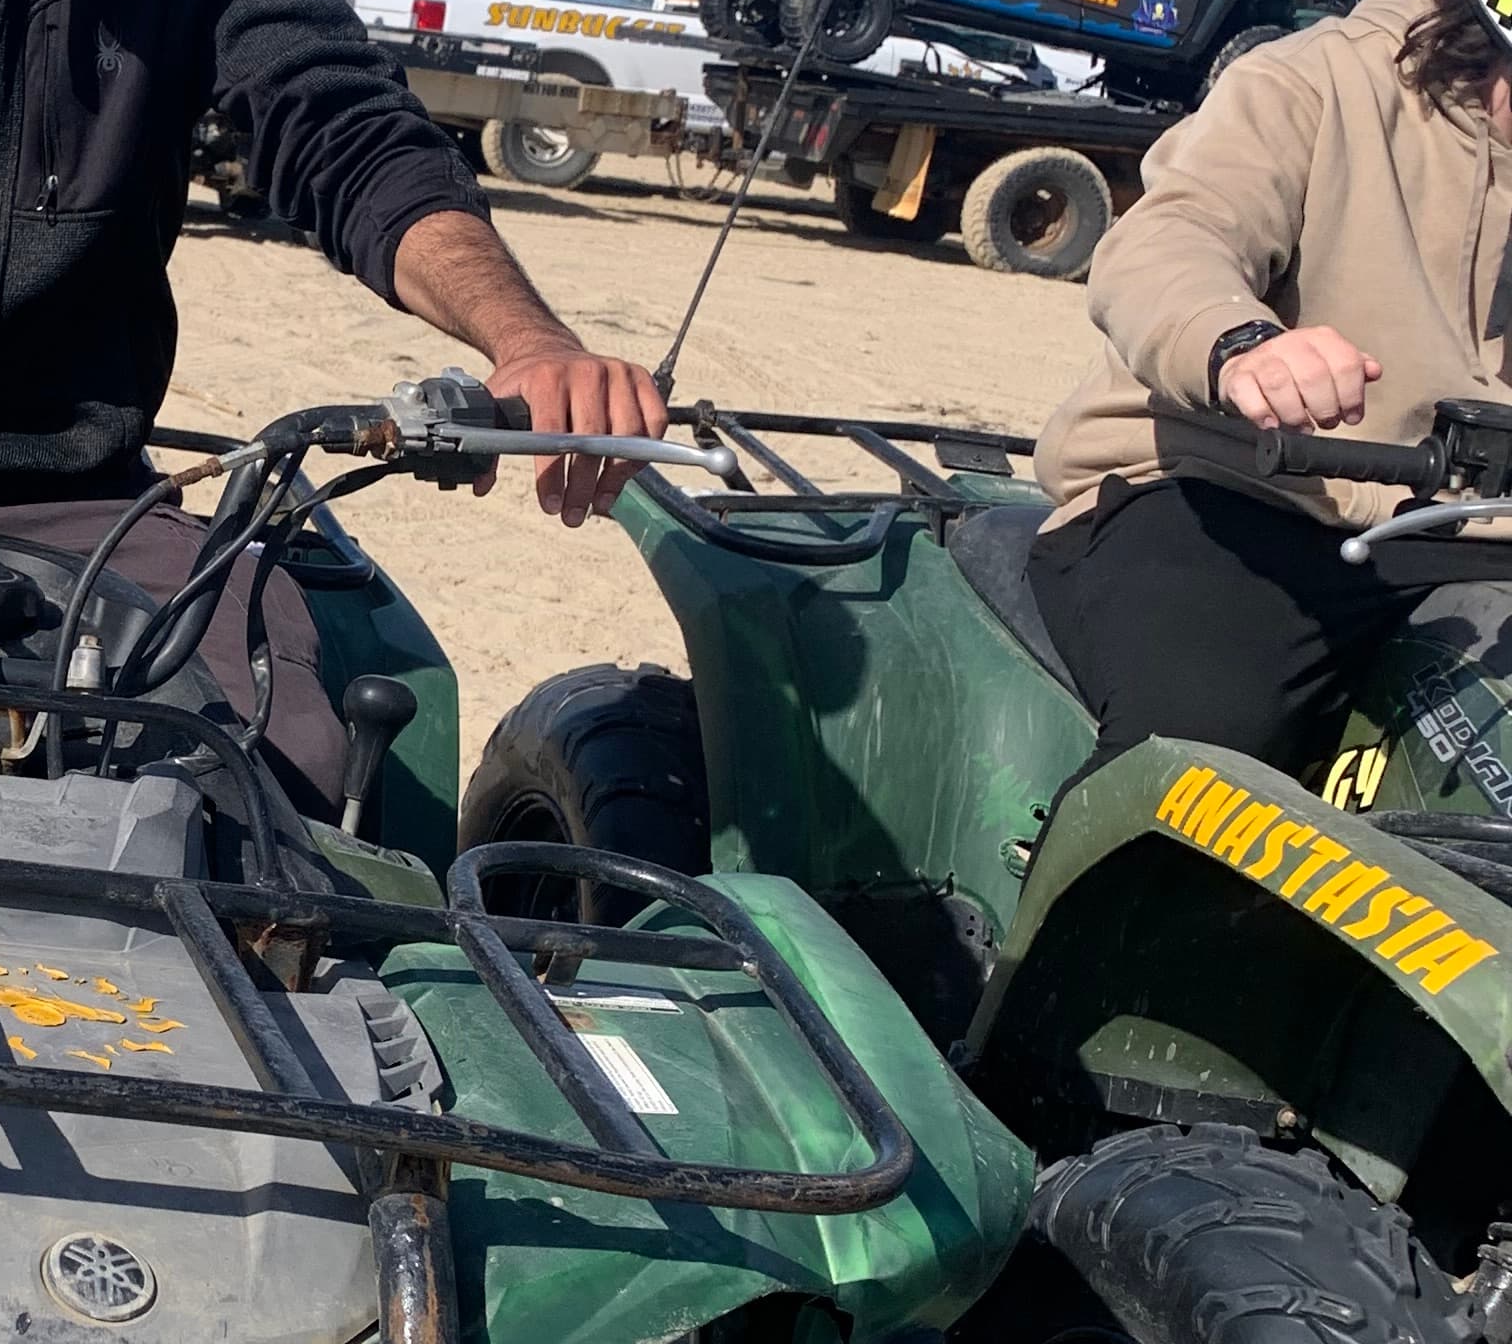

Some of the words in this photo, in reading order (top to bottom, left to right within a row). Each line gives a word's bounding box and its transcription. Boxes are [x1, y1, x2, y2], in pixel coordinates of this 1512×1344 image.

[486, 1, 686, 42] SUNBUG
[1406, 690, 1456, 763] 450
[1155, 764, 1500, 996] ANASTASIA
